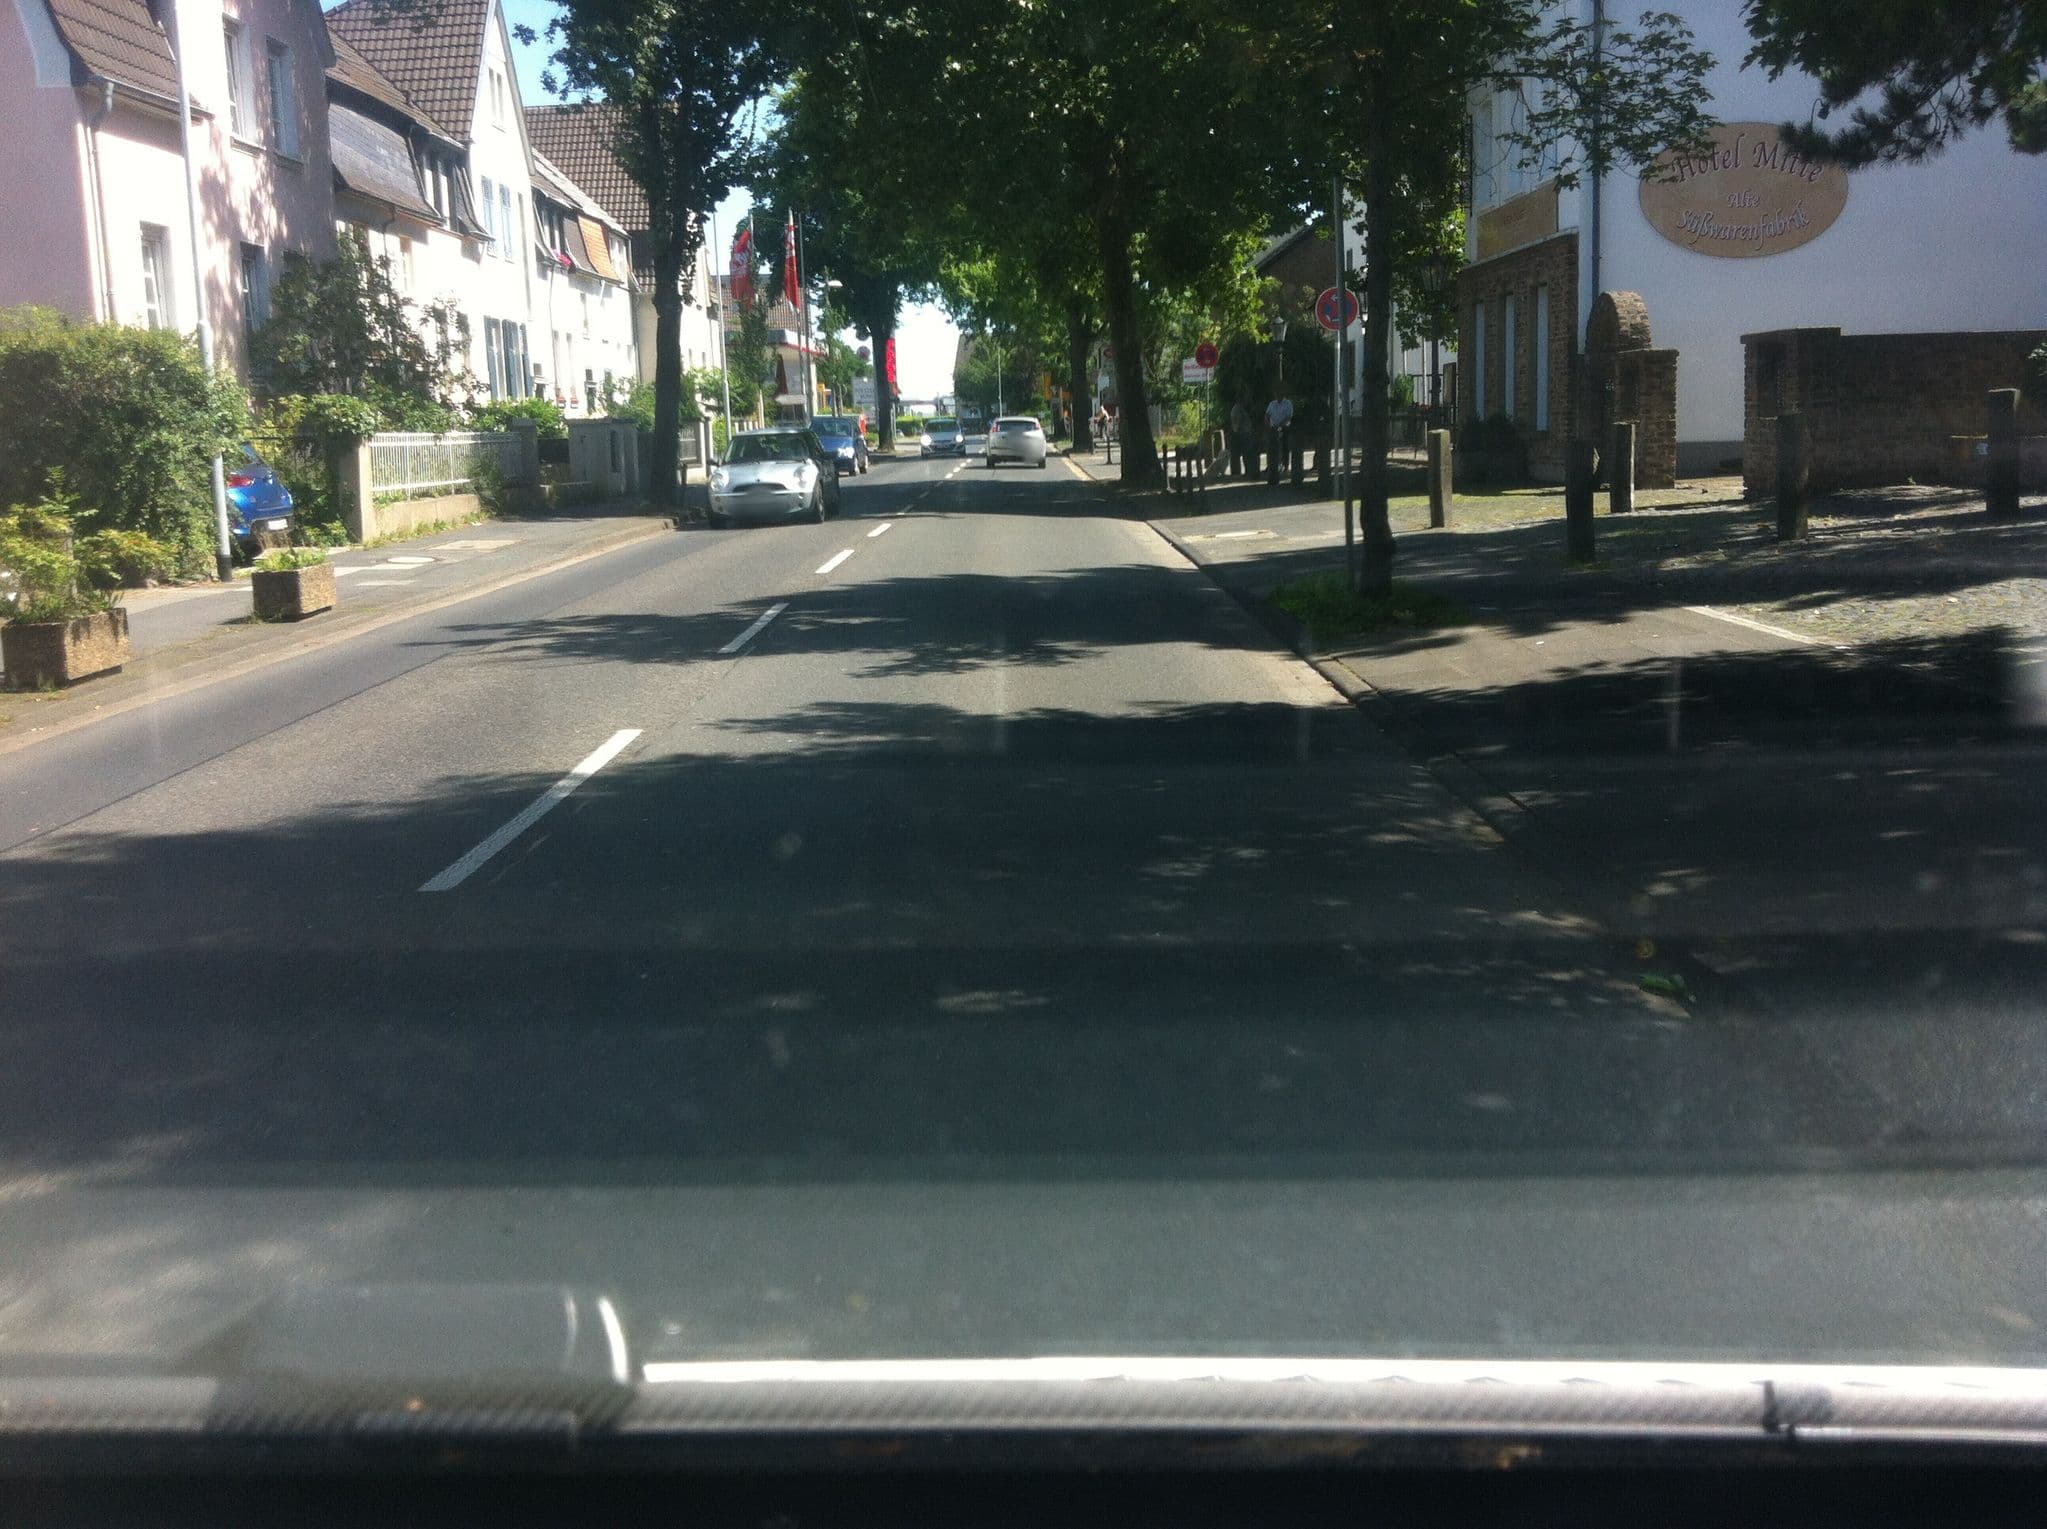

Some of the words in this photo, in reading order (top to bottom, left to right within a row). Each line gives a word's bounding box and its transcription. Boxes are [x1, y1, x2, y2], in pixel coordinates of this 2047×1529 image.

[1673, 133, 1746, 183] Hotel
[1753, 142, 1825, 183] Mitte
[1727, 188, 1761, 209] Alte
[1677, 199, 1810, 251] Süßwarenfabrik
